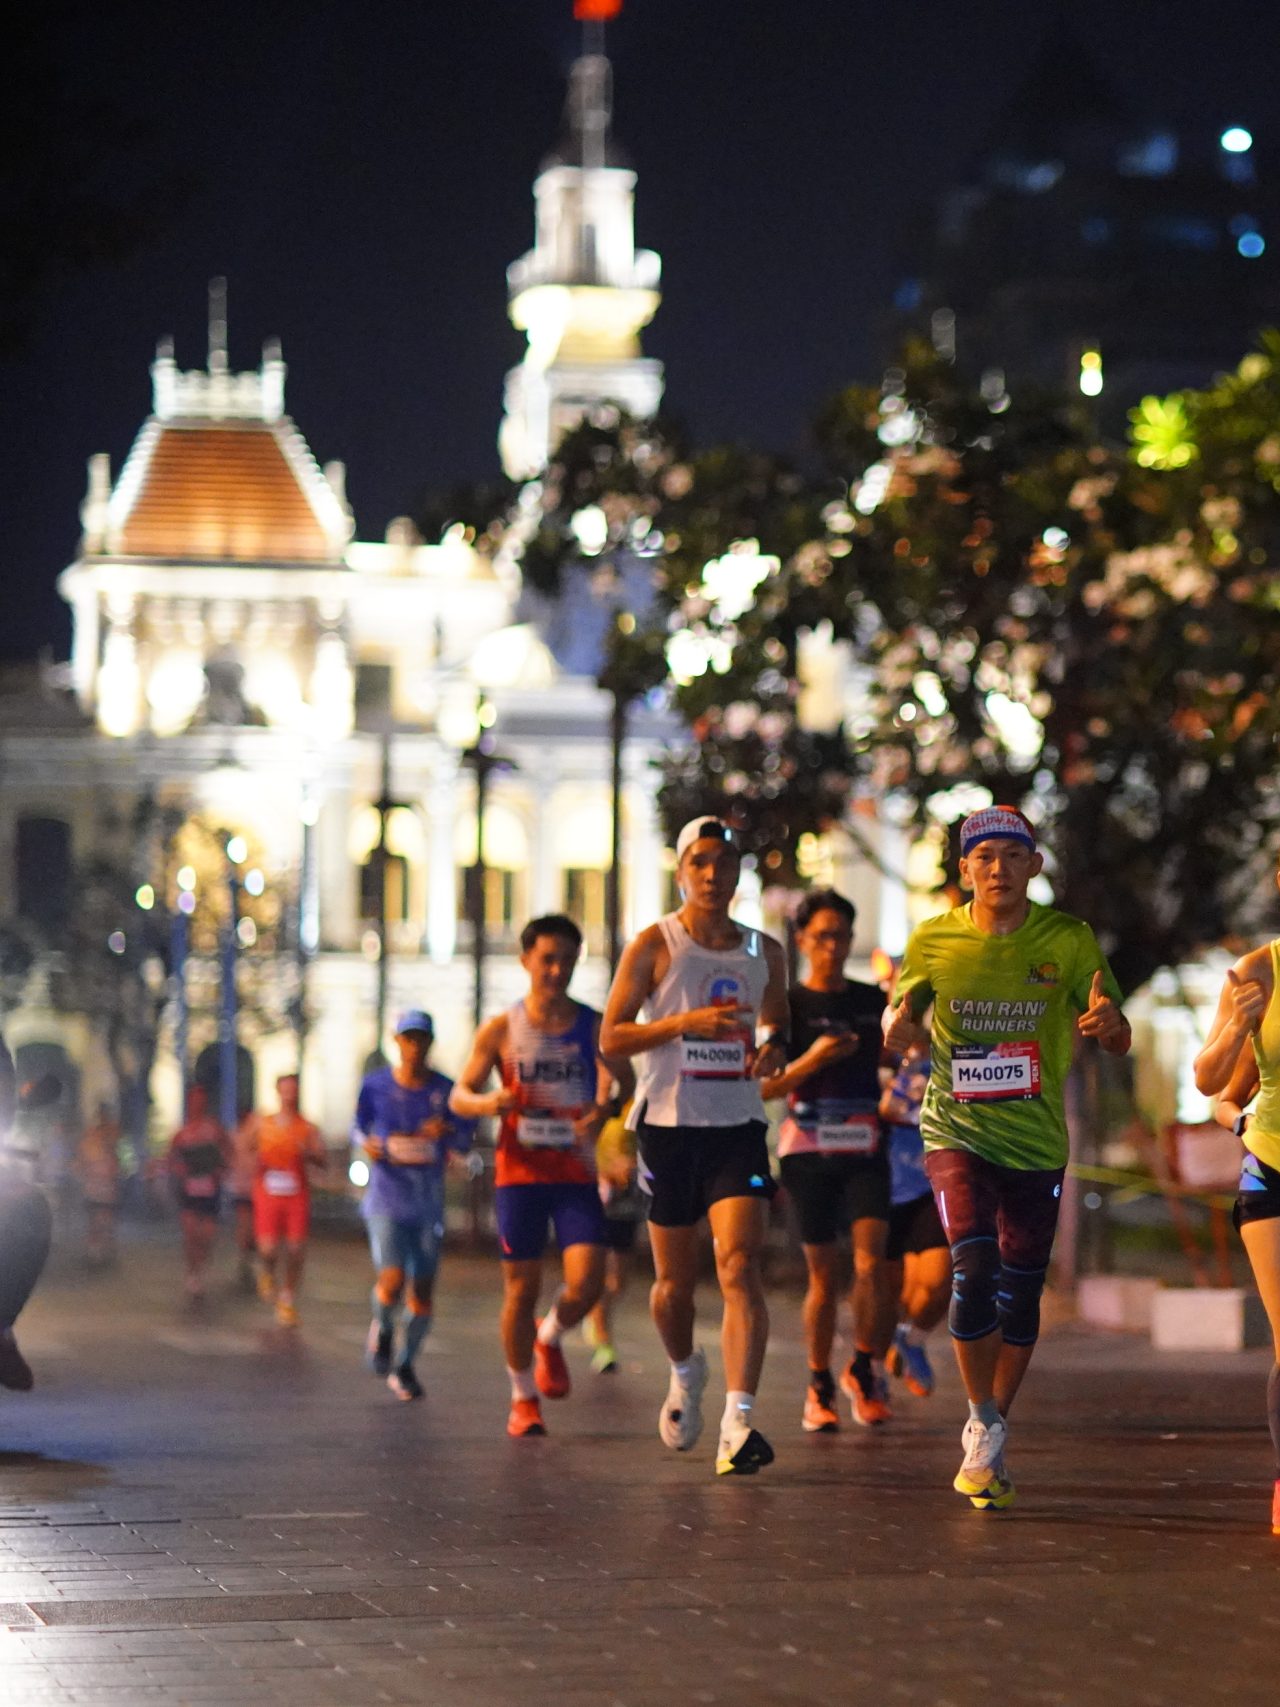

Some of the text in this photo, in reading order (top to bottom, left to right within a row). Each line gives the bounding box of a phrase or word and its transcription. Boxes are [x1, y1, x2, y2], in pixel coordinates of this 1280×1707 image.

[949, 999, 994, 1016] CAM
[962, 1018, 1036, 1032] RUNNERS
[958, 1064, 1024, 1082] M40075
